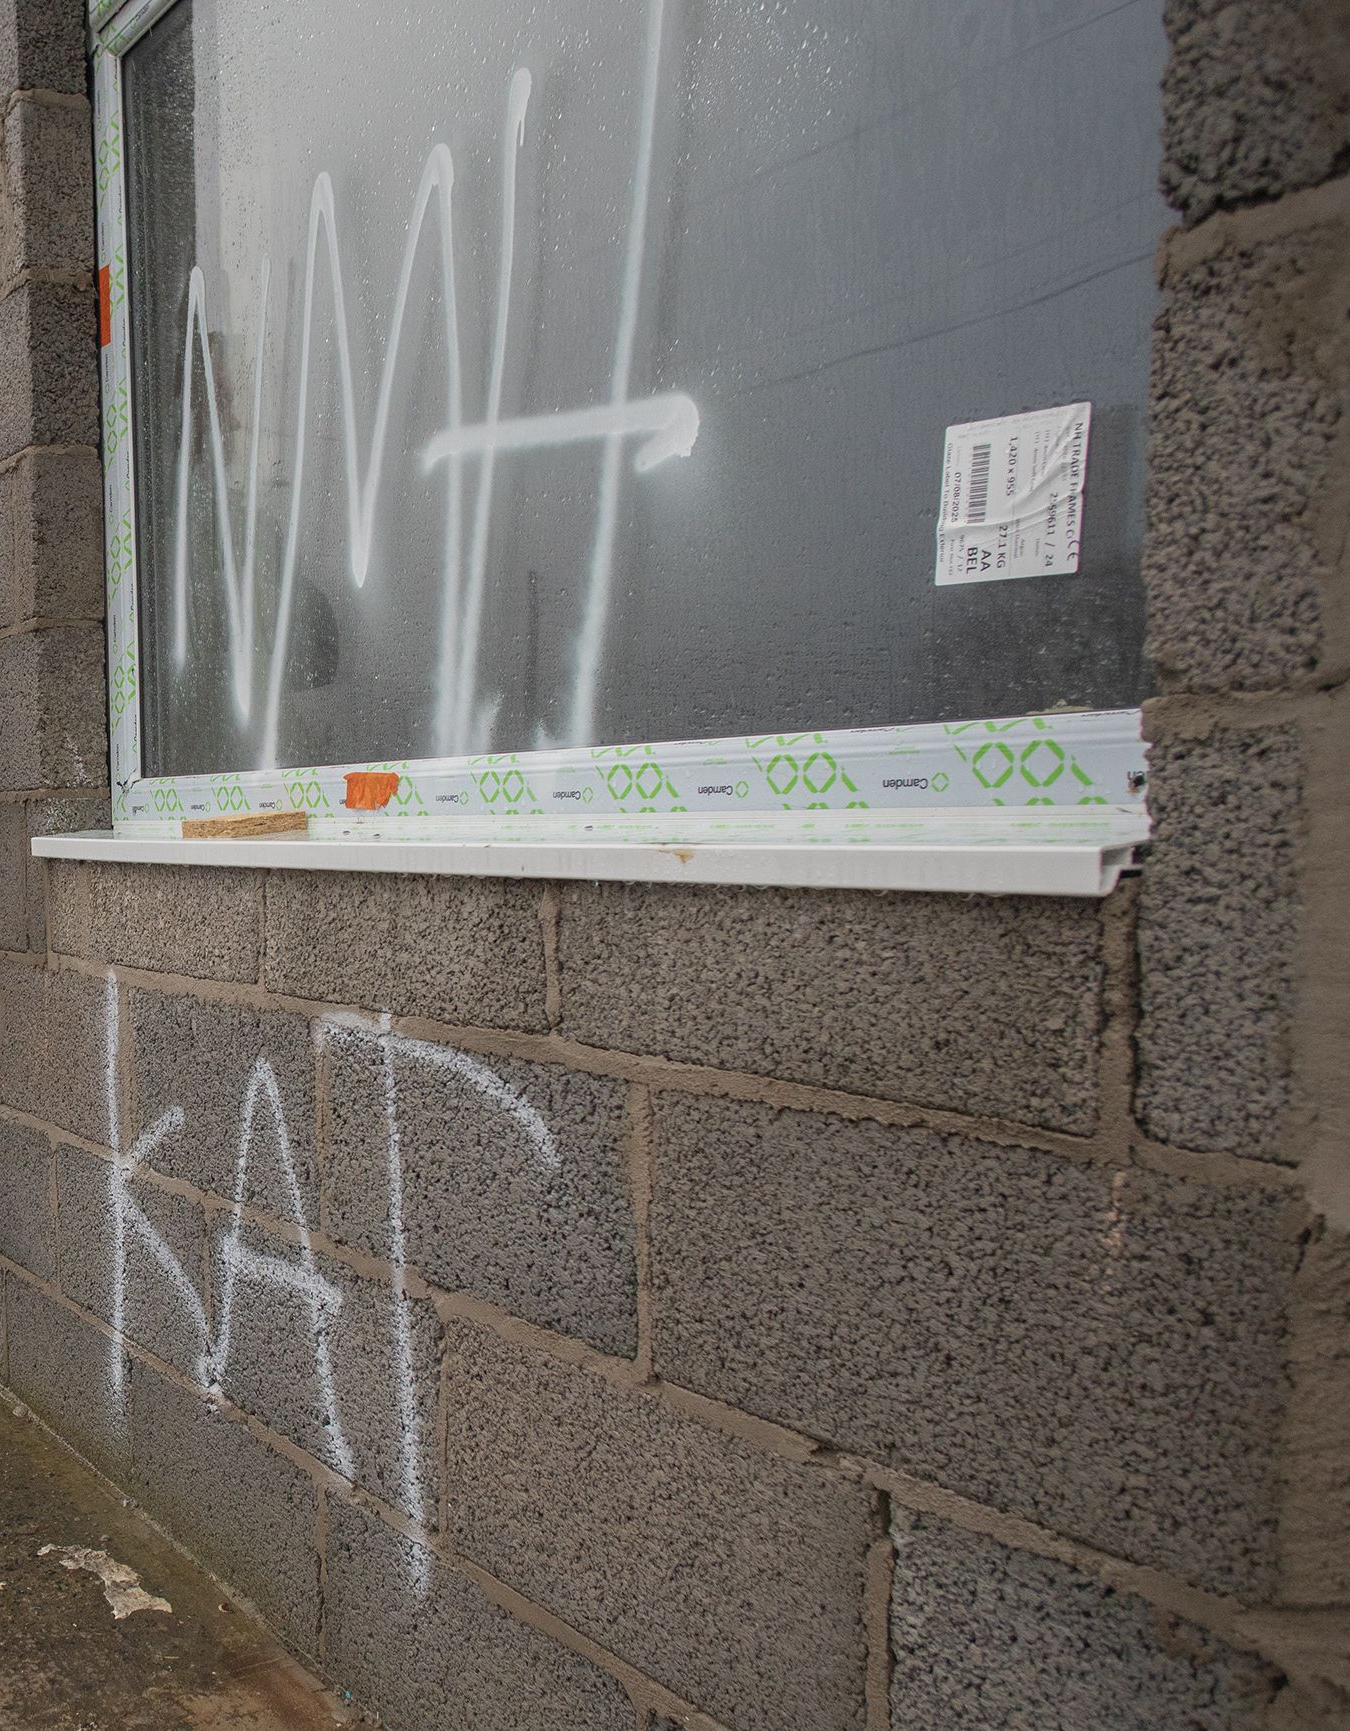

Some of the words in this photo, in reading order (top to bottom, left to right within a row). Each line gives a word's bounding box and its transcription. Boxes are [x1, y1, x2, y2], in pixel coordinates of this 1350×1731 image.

[1072, 422, 1083, 440] NH
[1069, 443, 1081, 478] TRADE
[1005, 476, 1015, 496] 955
[998, 525, 1008, 548] 27.1
[965, 546, 978, 574] BEL
[979, 548, 992, 571] AA
[996, 552, 1006, 568] KG
[1044, 553, 1054, 566] 24
[698, 784, 733, 796] Camden
[882, 778, 928, 789] Camden
[435, 794, 460, 804] Camden
[552, 790, 581, 800] Camden
[258, 801, 276, 809] Camden
